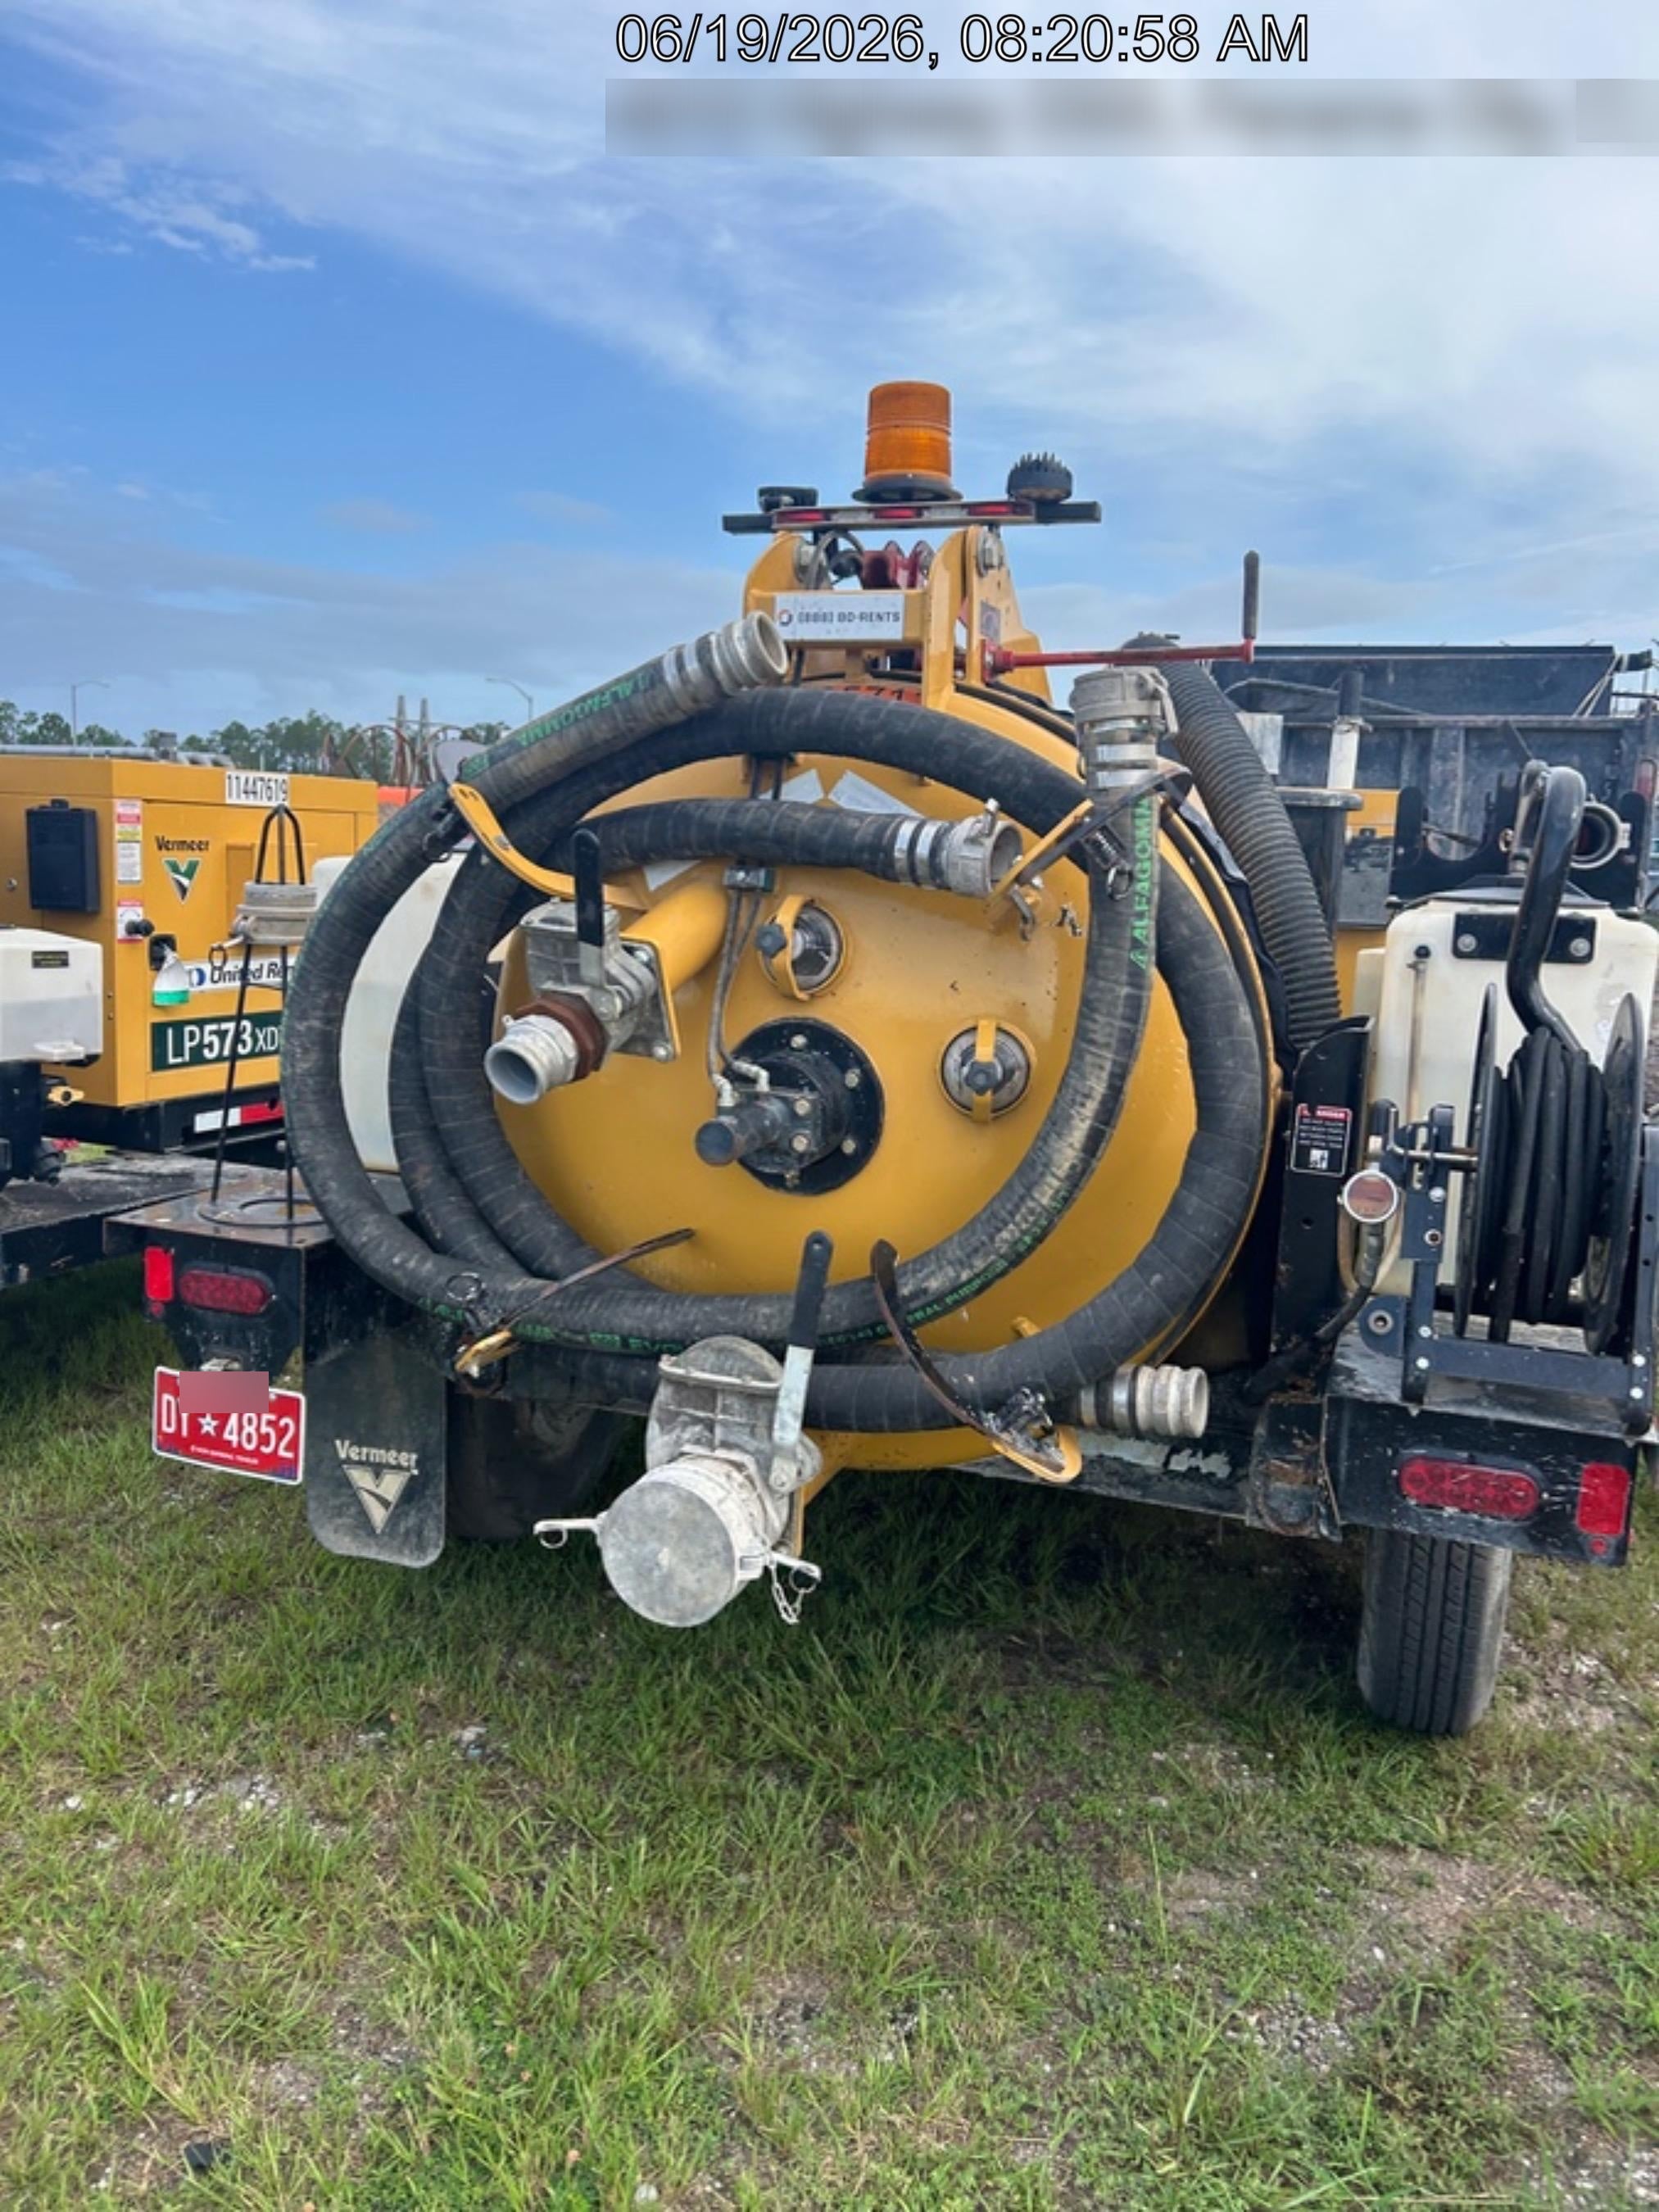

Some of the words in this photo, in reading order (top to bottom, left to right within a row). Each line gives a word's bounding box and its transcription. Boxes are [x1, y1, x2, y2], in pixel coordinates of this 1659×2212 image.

[228, 773, 288, 801] 11447619
[155, 836, 210, 851] Vermeer
[223, 1413, 295, 1459] 4852
[334, 1439, 419, 1469] Vermeer
